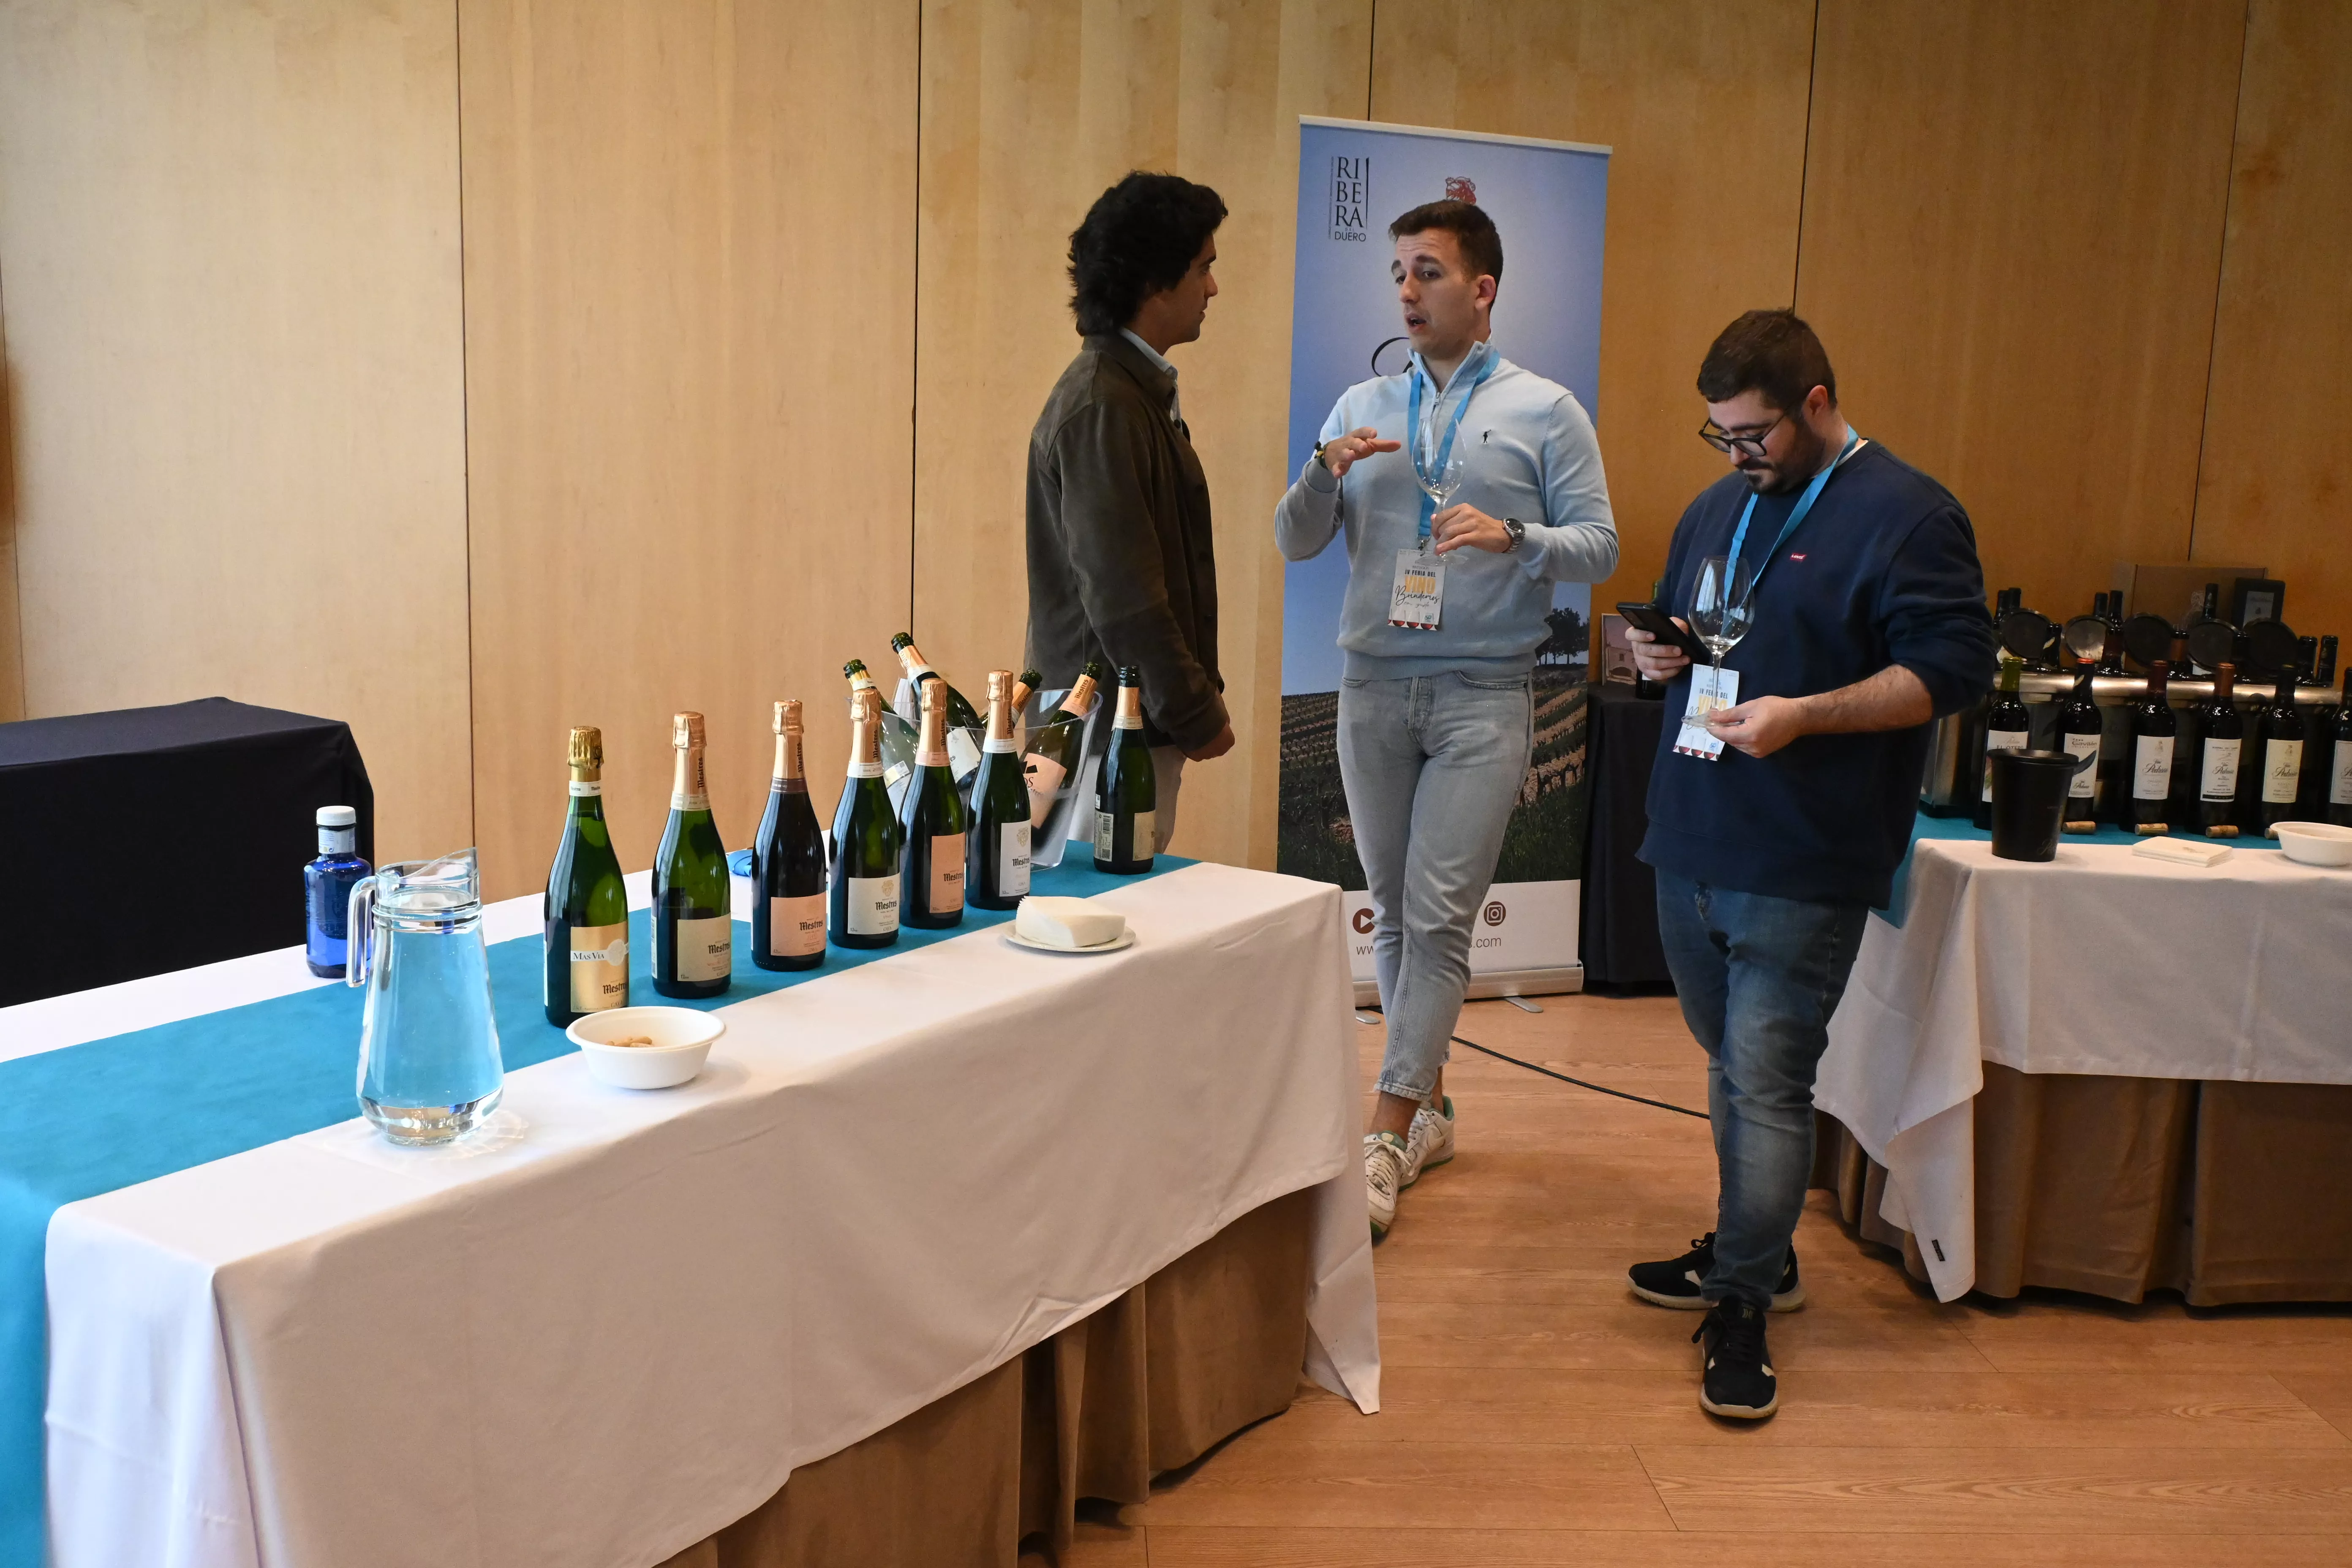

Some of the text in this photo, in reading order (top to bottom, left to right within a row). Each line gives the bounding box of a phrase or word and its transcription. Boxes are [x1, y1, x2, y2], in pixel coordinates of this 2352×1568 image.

[1335, 231, 1366, 242] DUERO
[1405, 575, 1436, 594] VINO
[1074, 679, 1089, 699] Mestres
[875, 900, 897, 910] Mestres
[799, 920, 823, 931] Mestres
